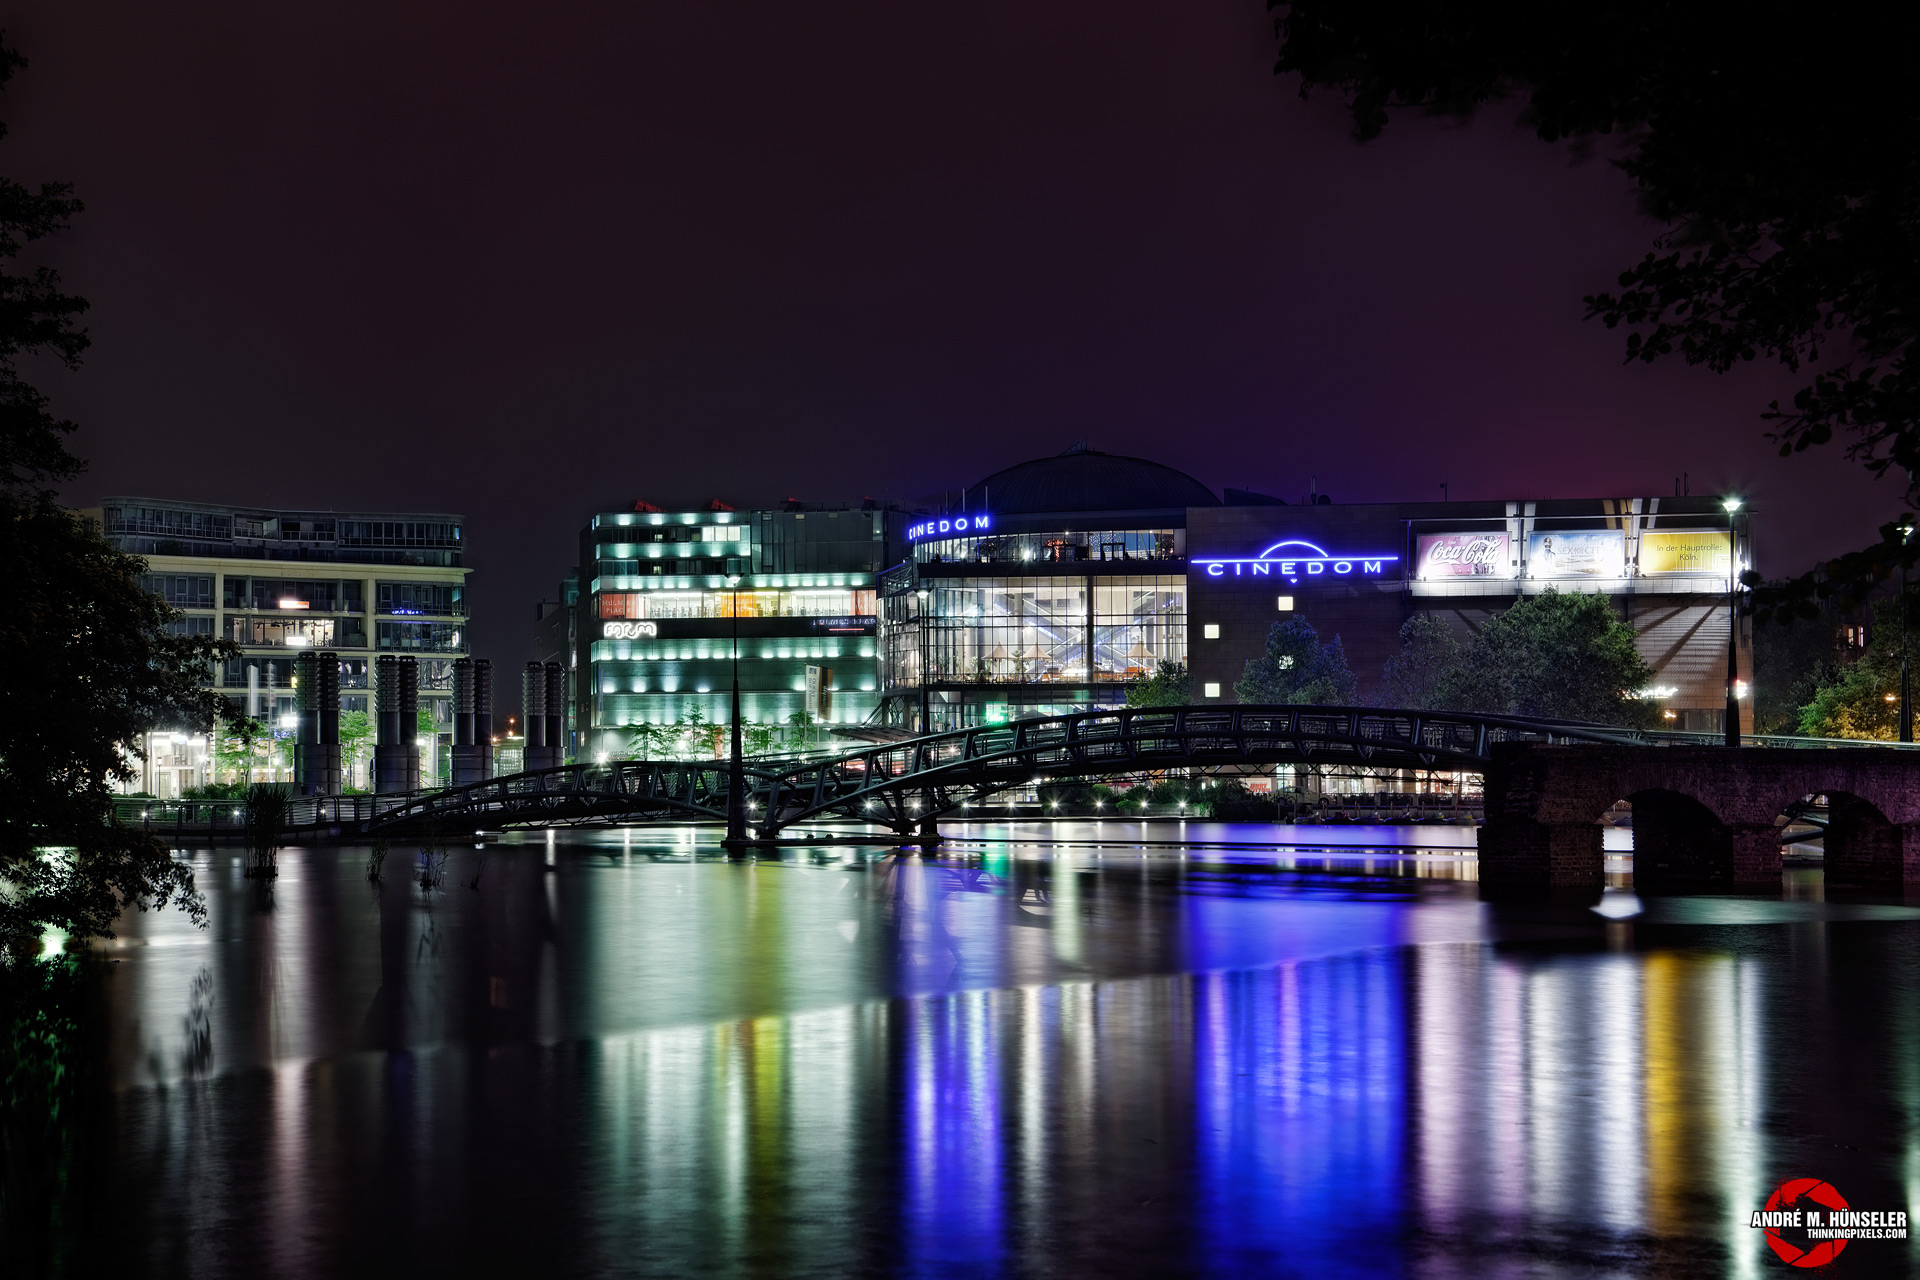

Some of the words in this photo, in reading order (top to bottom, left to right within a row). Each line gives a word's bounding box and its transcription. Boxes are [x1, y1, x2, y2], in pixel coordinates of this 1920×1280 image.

[909, 516, 988, 540] CINEDOM
[1426, 540, 1503, 566] Coca-Cola
[1666, 544, 1678, 552] der
[1680, 543, 1722, 552] Hauptrolle:
[1679, 553, 1699, 561] Köln.
[1207, 560, 1382, 576] CINEDOM
